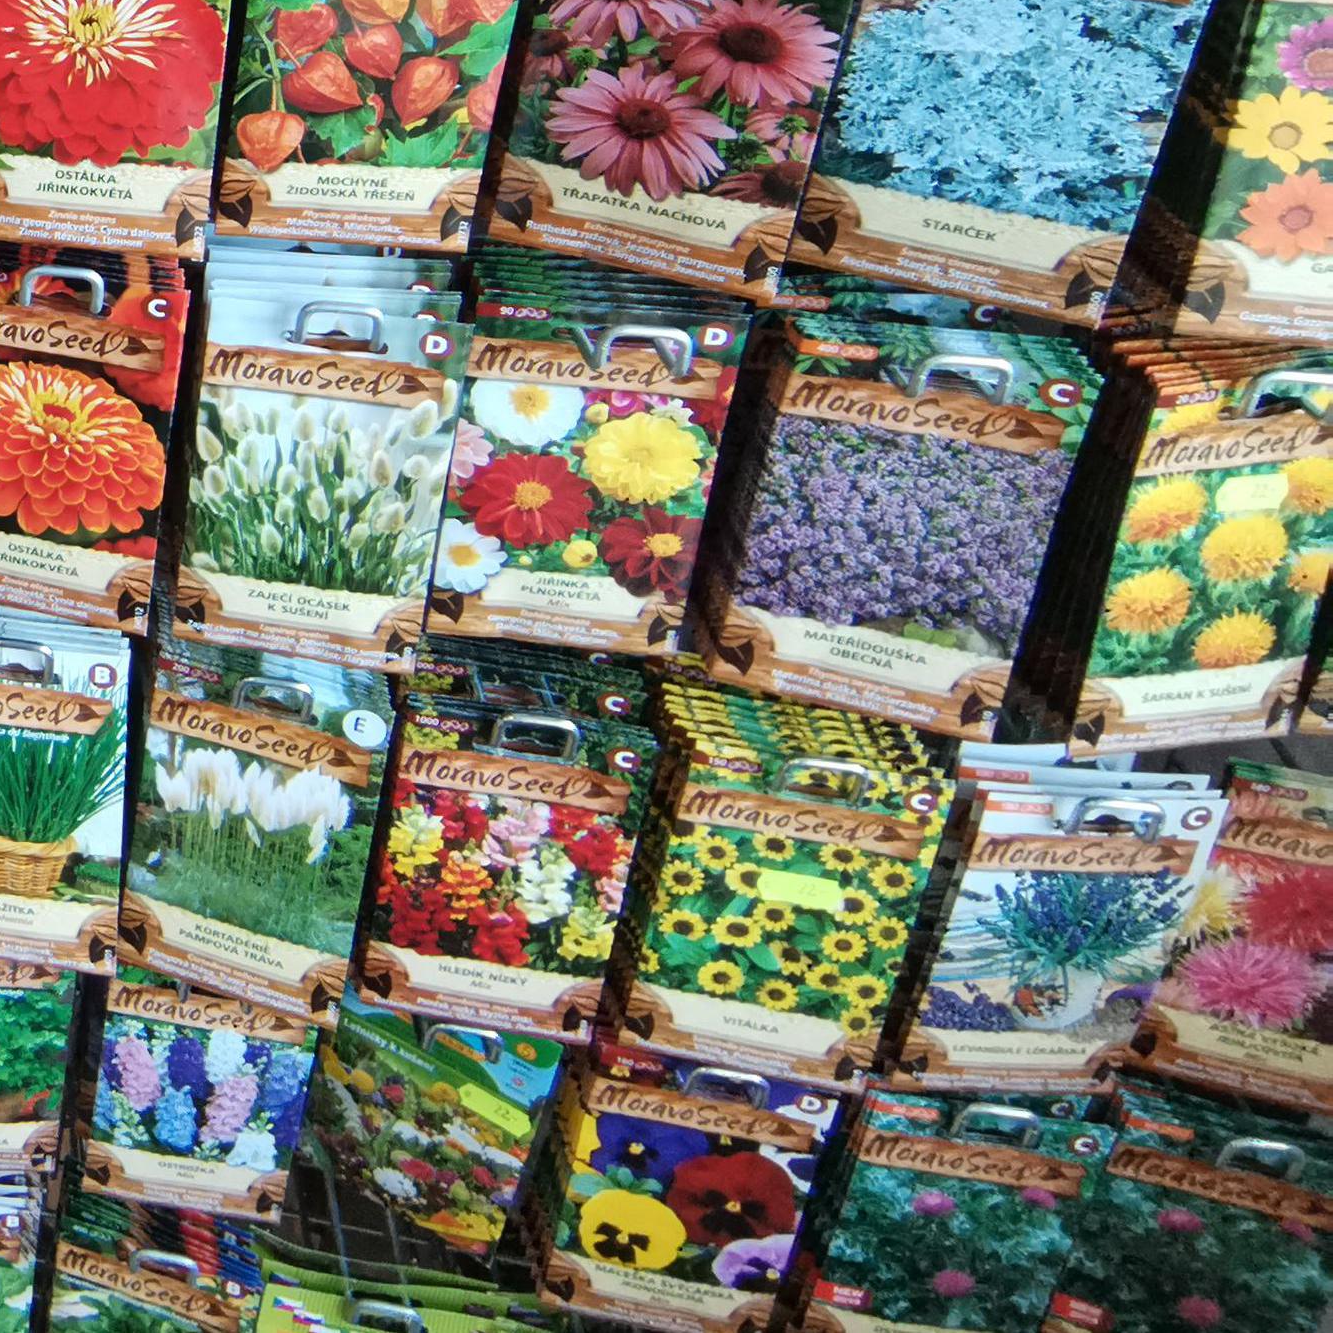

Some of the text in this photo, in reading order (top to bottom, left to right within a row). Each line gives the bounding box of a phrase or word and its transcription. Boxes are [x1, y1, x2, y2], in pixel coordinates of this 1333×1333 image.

[55, 167, 117, 185] OSTÁLKA
[317, 173, 389, 191] MOCHYNĚ
[35, 178, 134, 202] JIŘINKOKVĚTÁ
[286, 180, 358, 201] ŽIDOVSKÁ
[645, 201, 729, 233] NACHOVÁ
[921, 215, 998, 245] STARČEK
[210, 349, 390, 396] MoravoSeed
[790, 379, 1003, 439] MoravoSeed
[8, 541, 65, 563] OSTÁLKA
[267, 602, 331, 622] K SUŠENÍ
[296, 594, 352, 614] OCÁSEK
[830, 645, 894, 671] OBECNÁ
[156, 697, 327, 761] MoravoSeed
[403, 749, 573, 799] MoravoSeed
[686, 790, 864, 843] MoravoSeed
